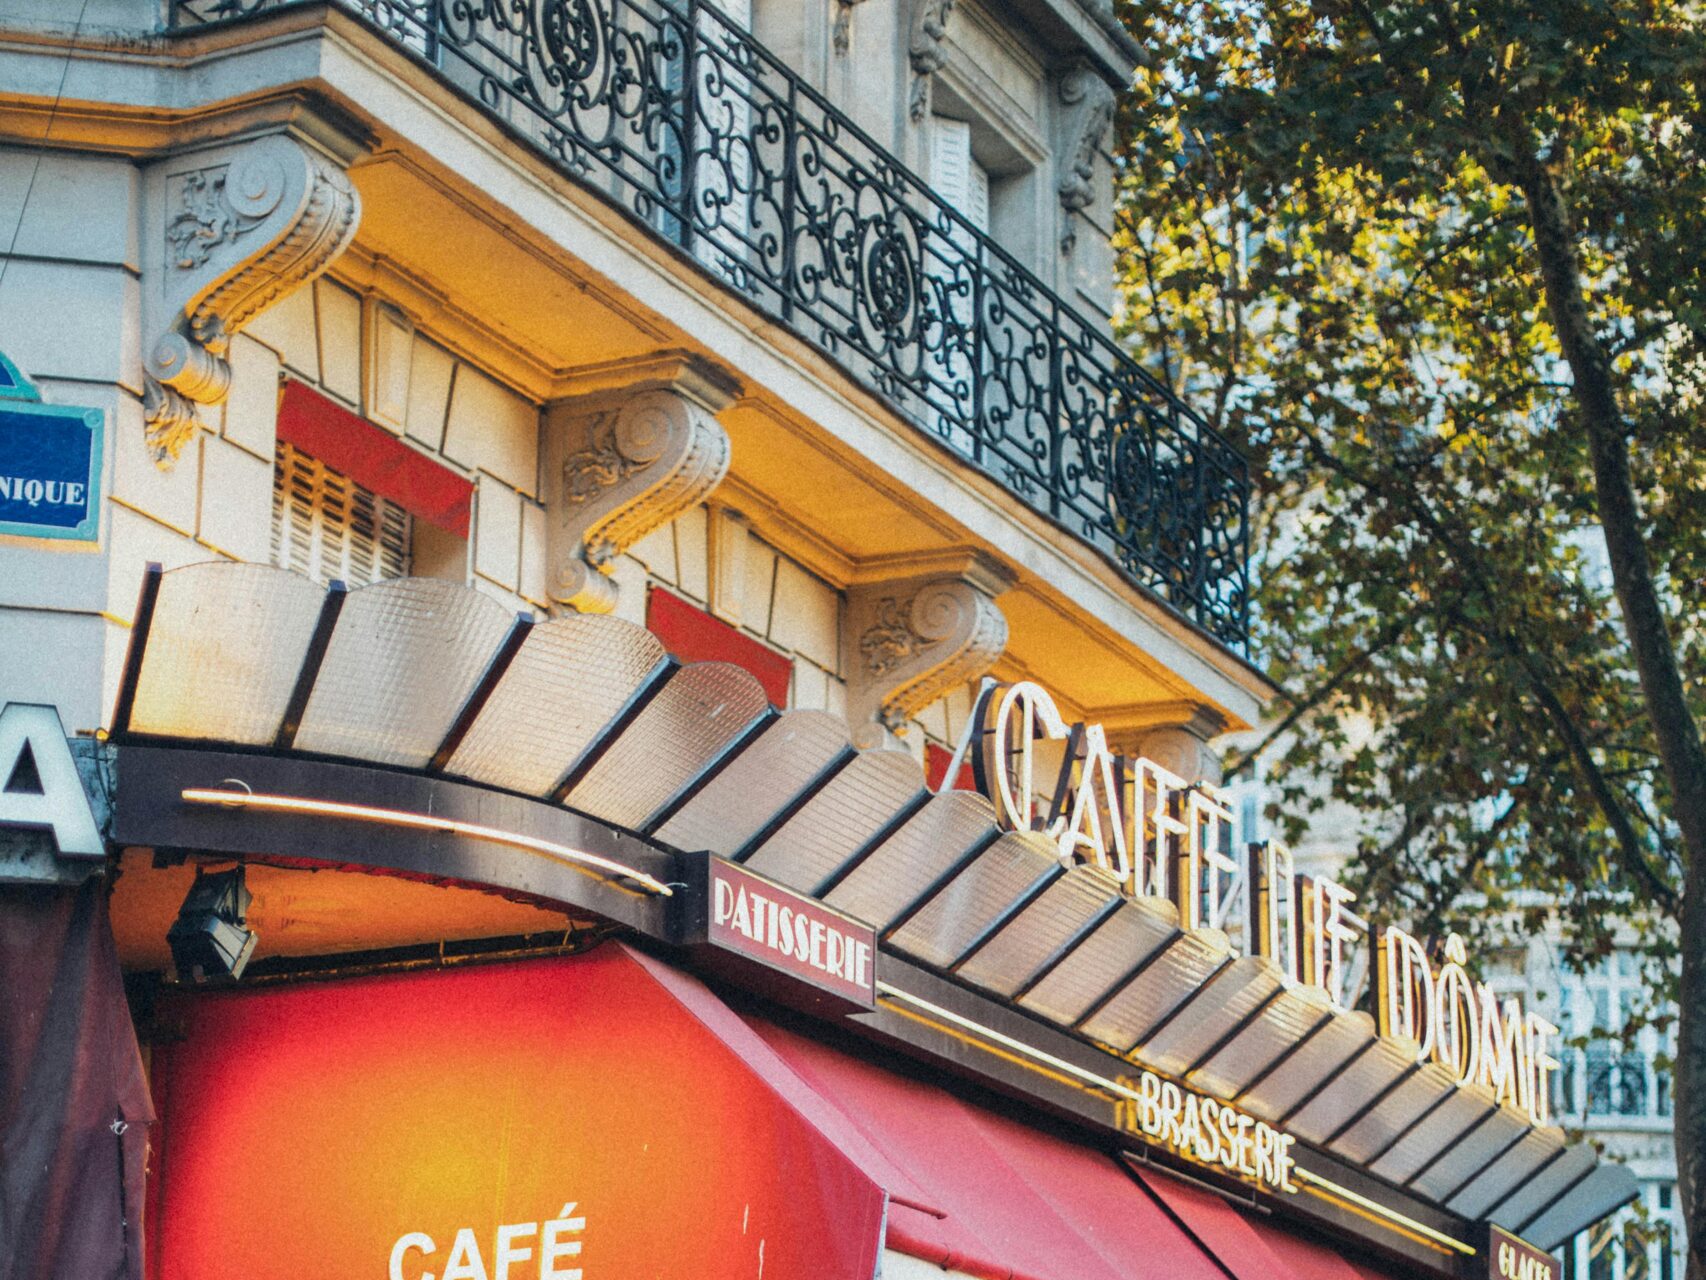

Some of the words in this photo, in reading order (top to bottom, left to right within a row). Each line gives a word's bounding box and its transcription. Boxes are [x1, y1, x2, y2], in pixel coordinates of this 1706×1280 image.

[714, 877, 871, 989] PATISSERIE
[1267, 837, 1360, 1016] LE
[1386, 925, 1561, 1128] DÔME
[1140, 1071, 1299, 1194] BRASSERIE
